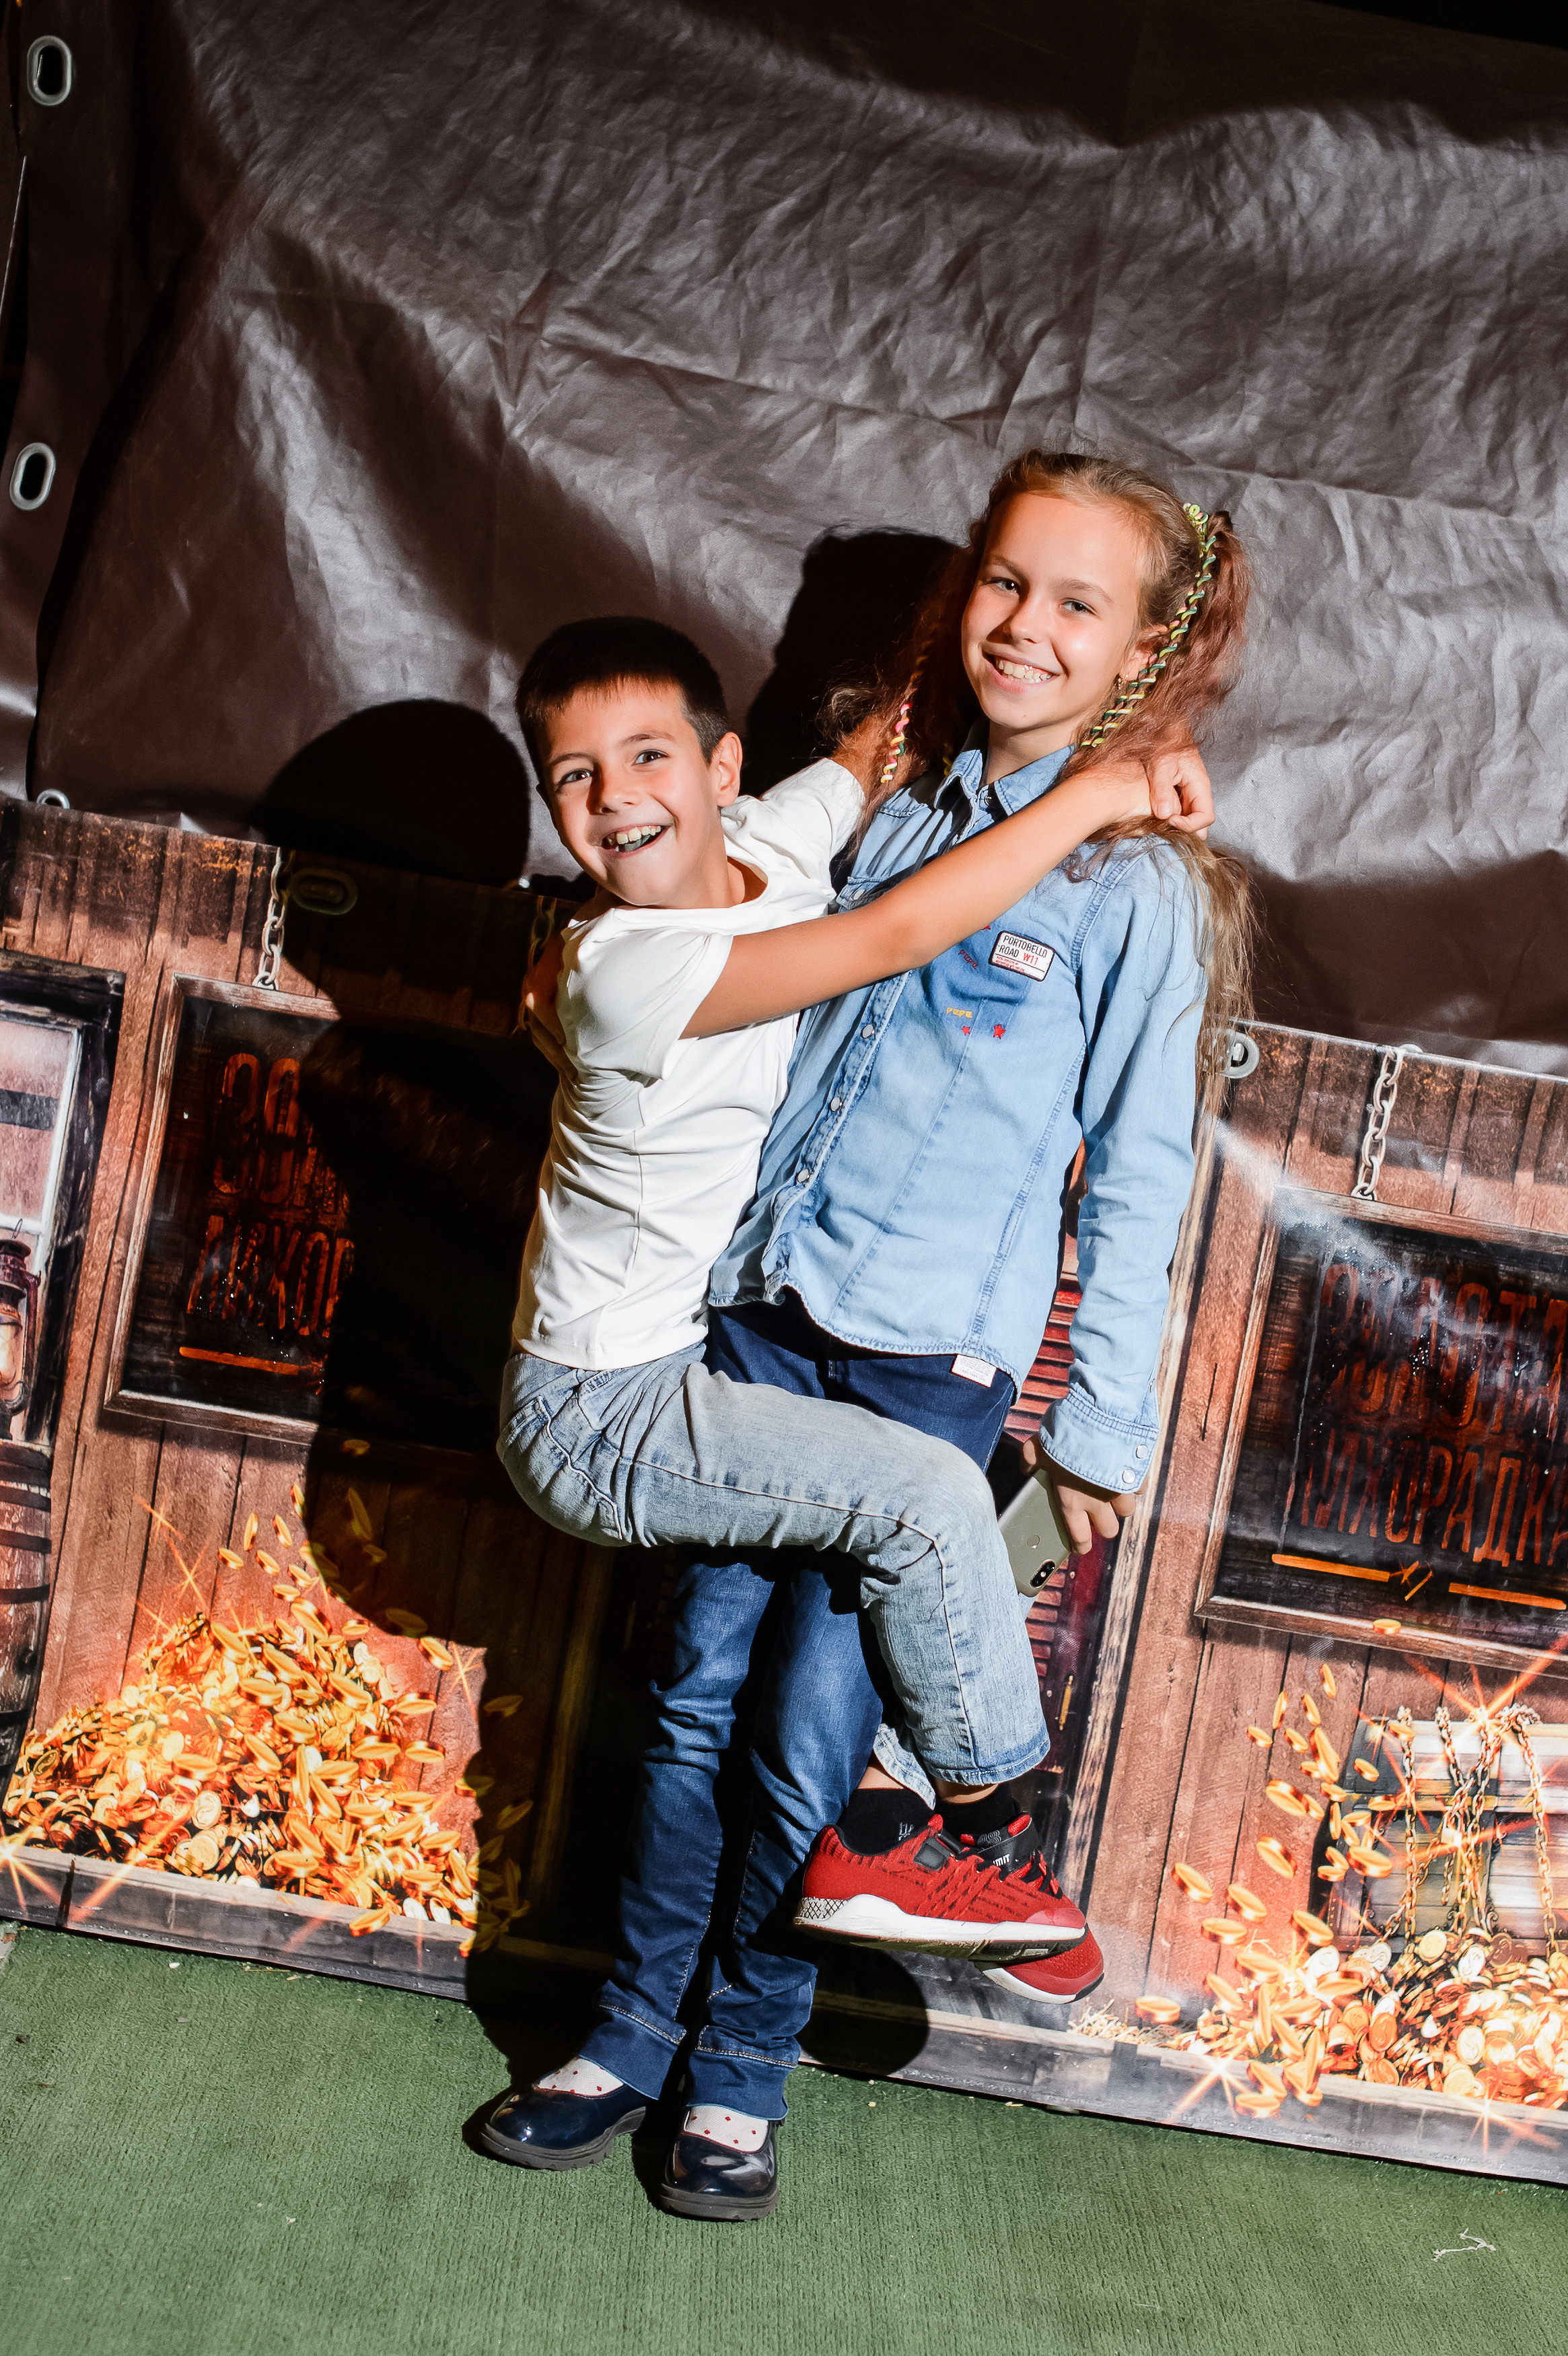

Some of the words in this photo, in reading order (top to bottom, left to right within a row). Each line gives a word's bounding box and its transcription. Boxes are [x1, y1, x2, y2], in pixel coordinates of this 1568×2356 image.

[999, 944, 1020, 958] ROAD
[1023, 952, 1038, 965] W11
[1003, 935, 1048, 958] PORTOBELLO
